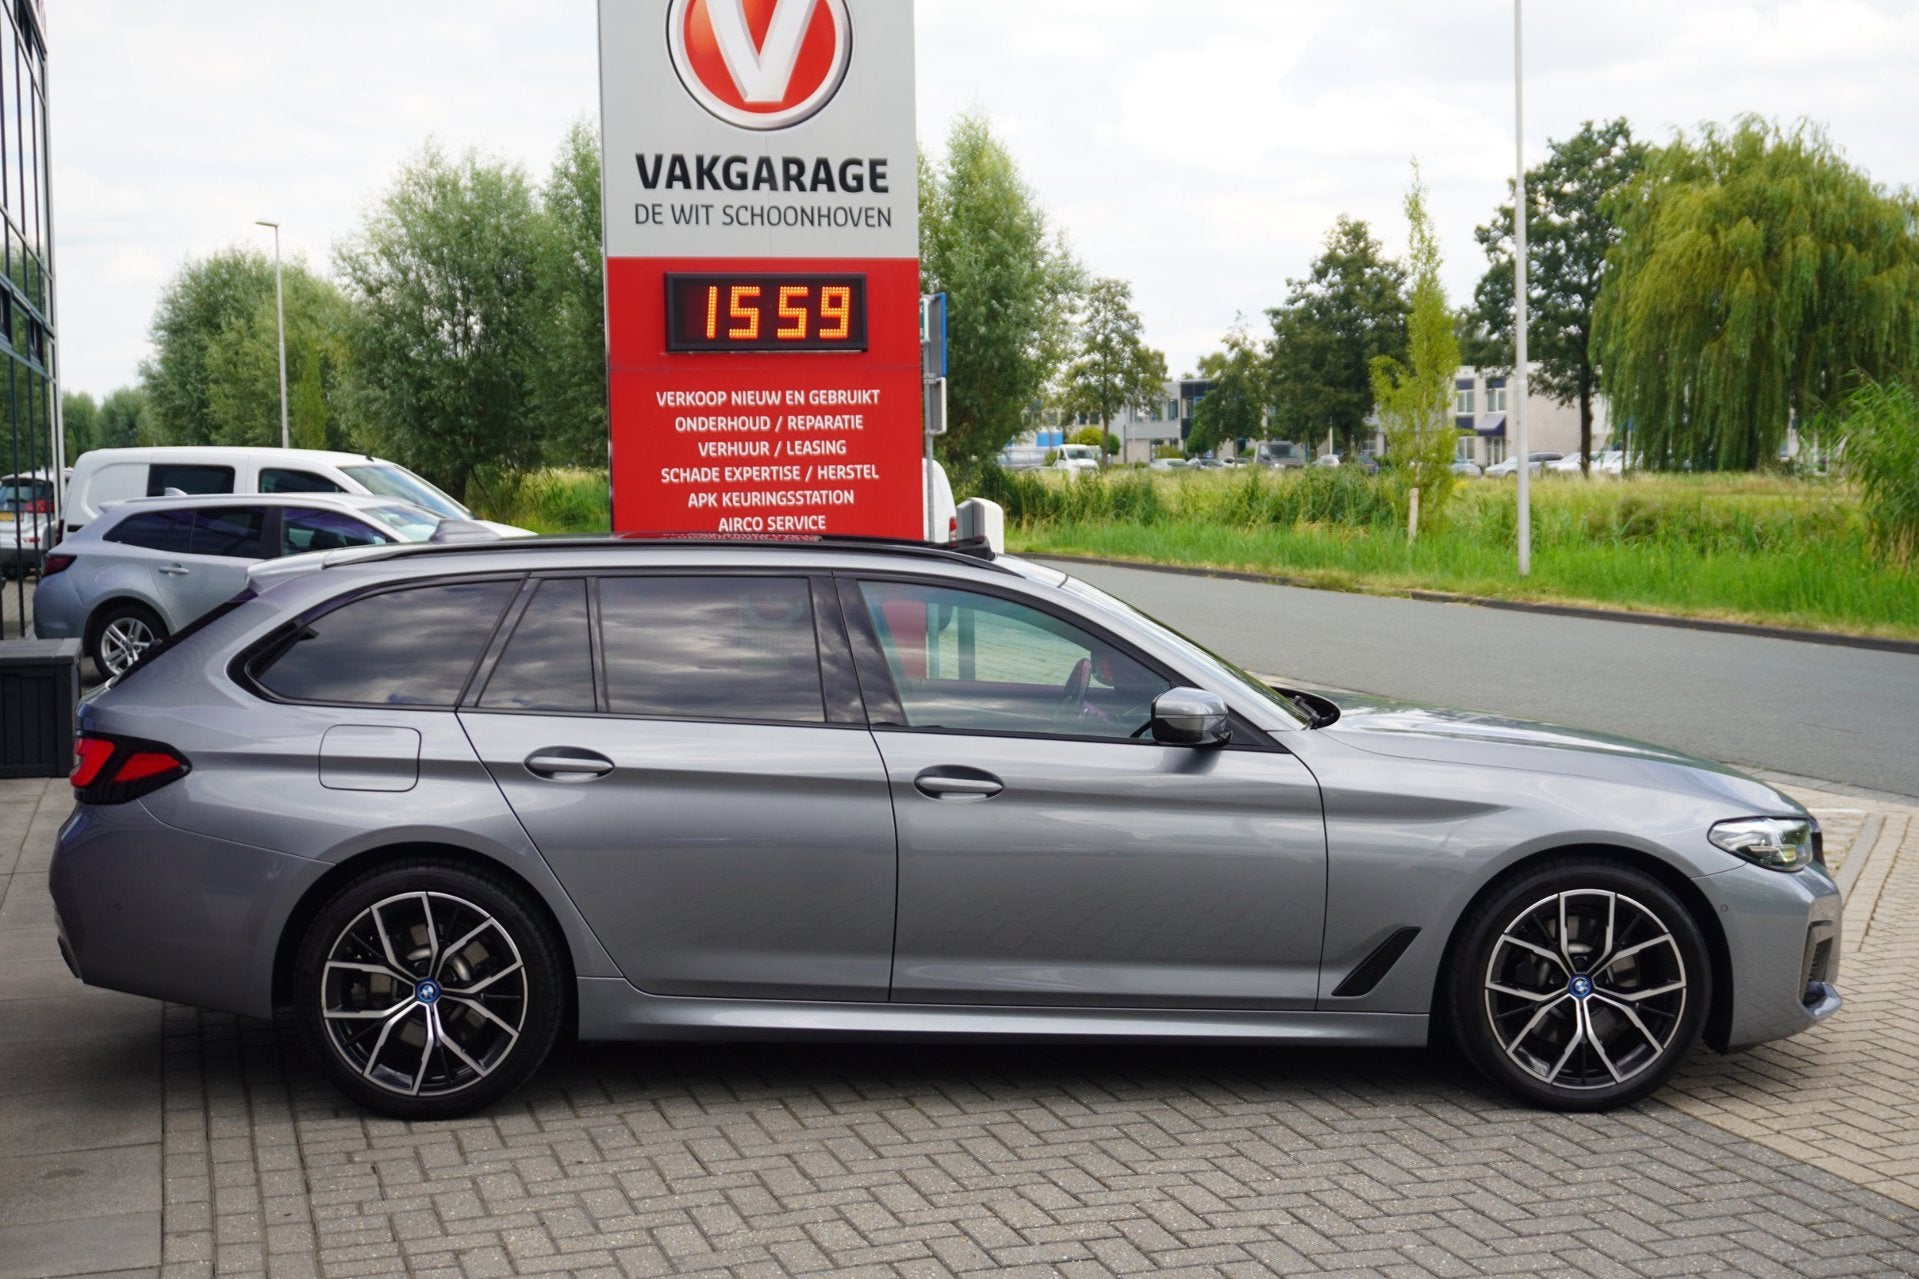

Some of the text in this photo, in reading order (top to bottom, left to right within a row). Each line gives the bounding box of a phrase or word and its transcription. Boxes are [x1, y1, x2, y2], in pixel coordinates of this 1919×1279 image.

[635, 153, 889, 194] VAKGARAGE
[634, 203, 892, 228] DE WIT SCHOONHOVEN
[655, 388, 881, 407] VERKOOP NIEUW EN GEBRUIKT
[674, 414, 864, 433] ONDERHOUD / REPARATIE
[697, 439, 847, 458] VERHUUR / LEASING
[661, 463, 880, 484] SCHADE EXPERTISE / HERSTEL
[687, 489, 855, 508] APK KEURINGSSTATION
[718, 514, 827, 533] AIRCO SERVICE
